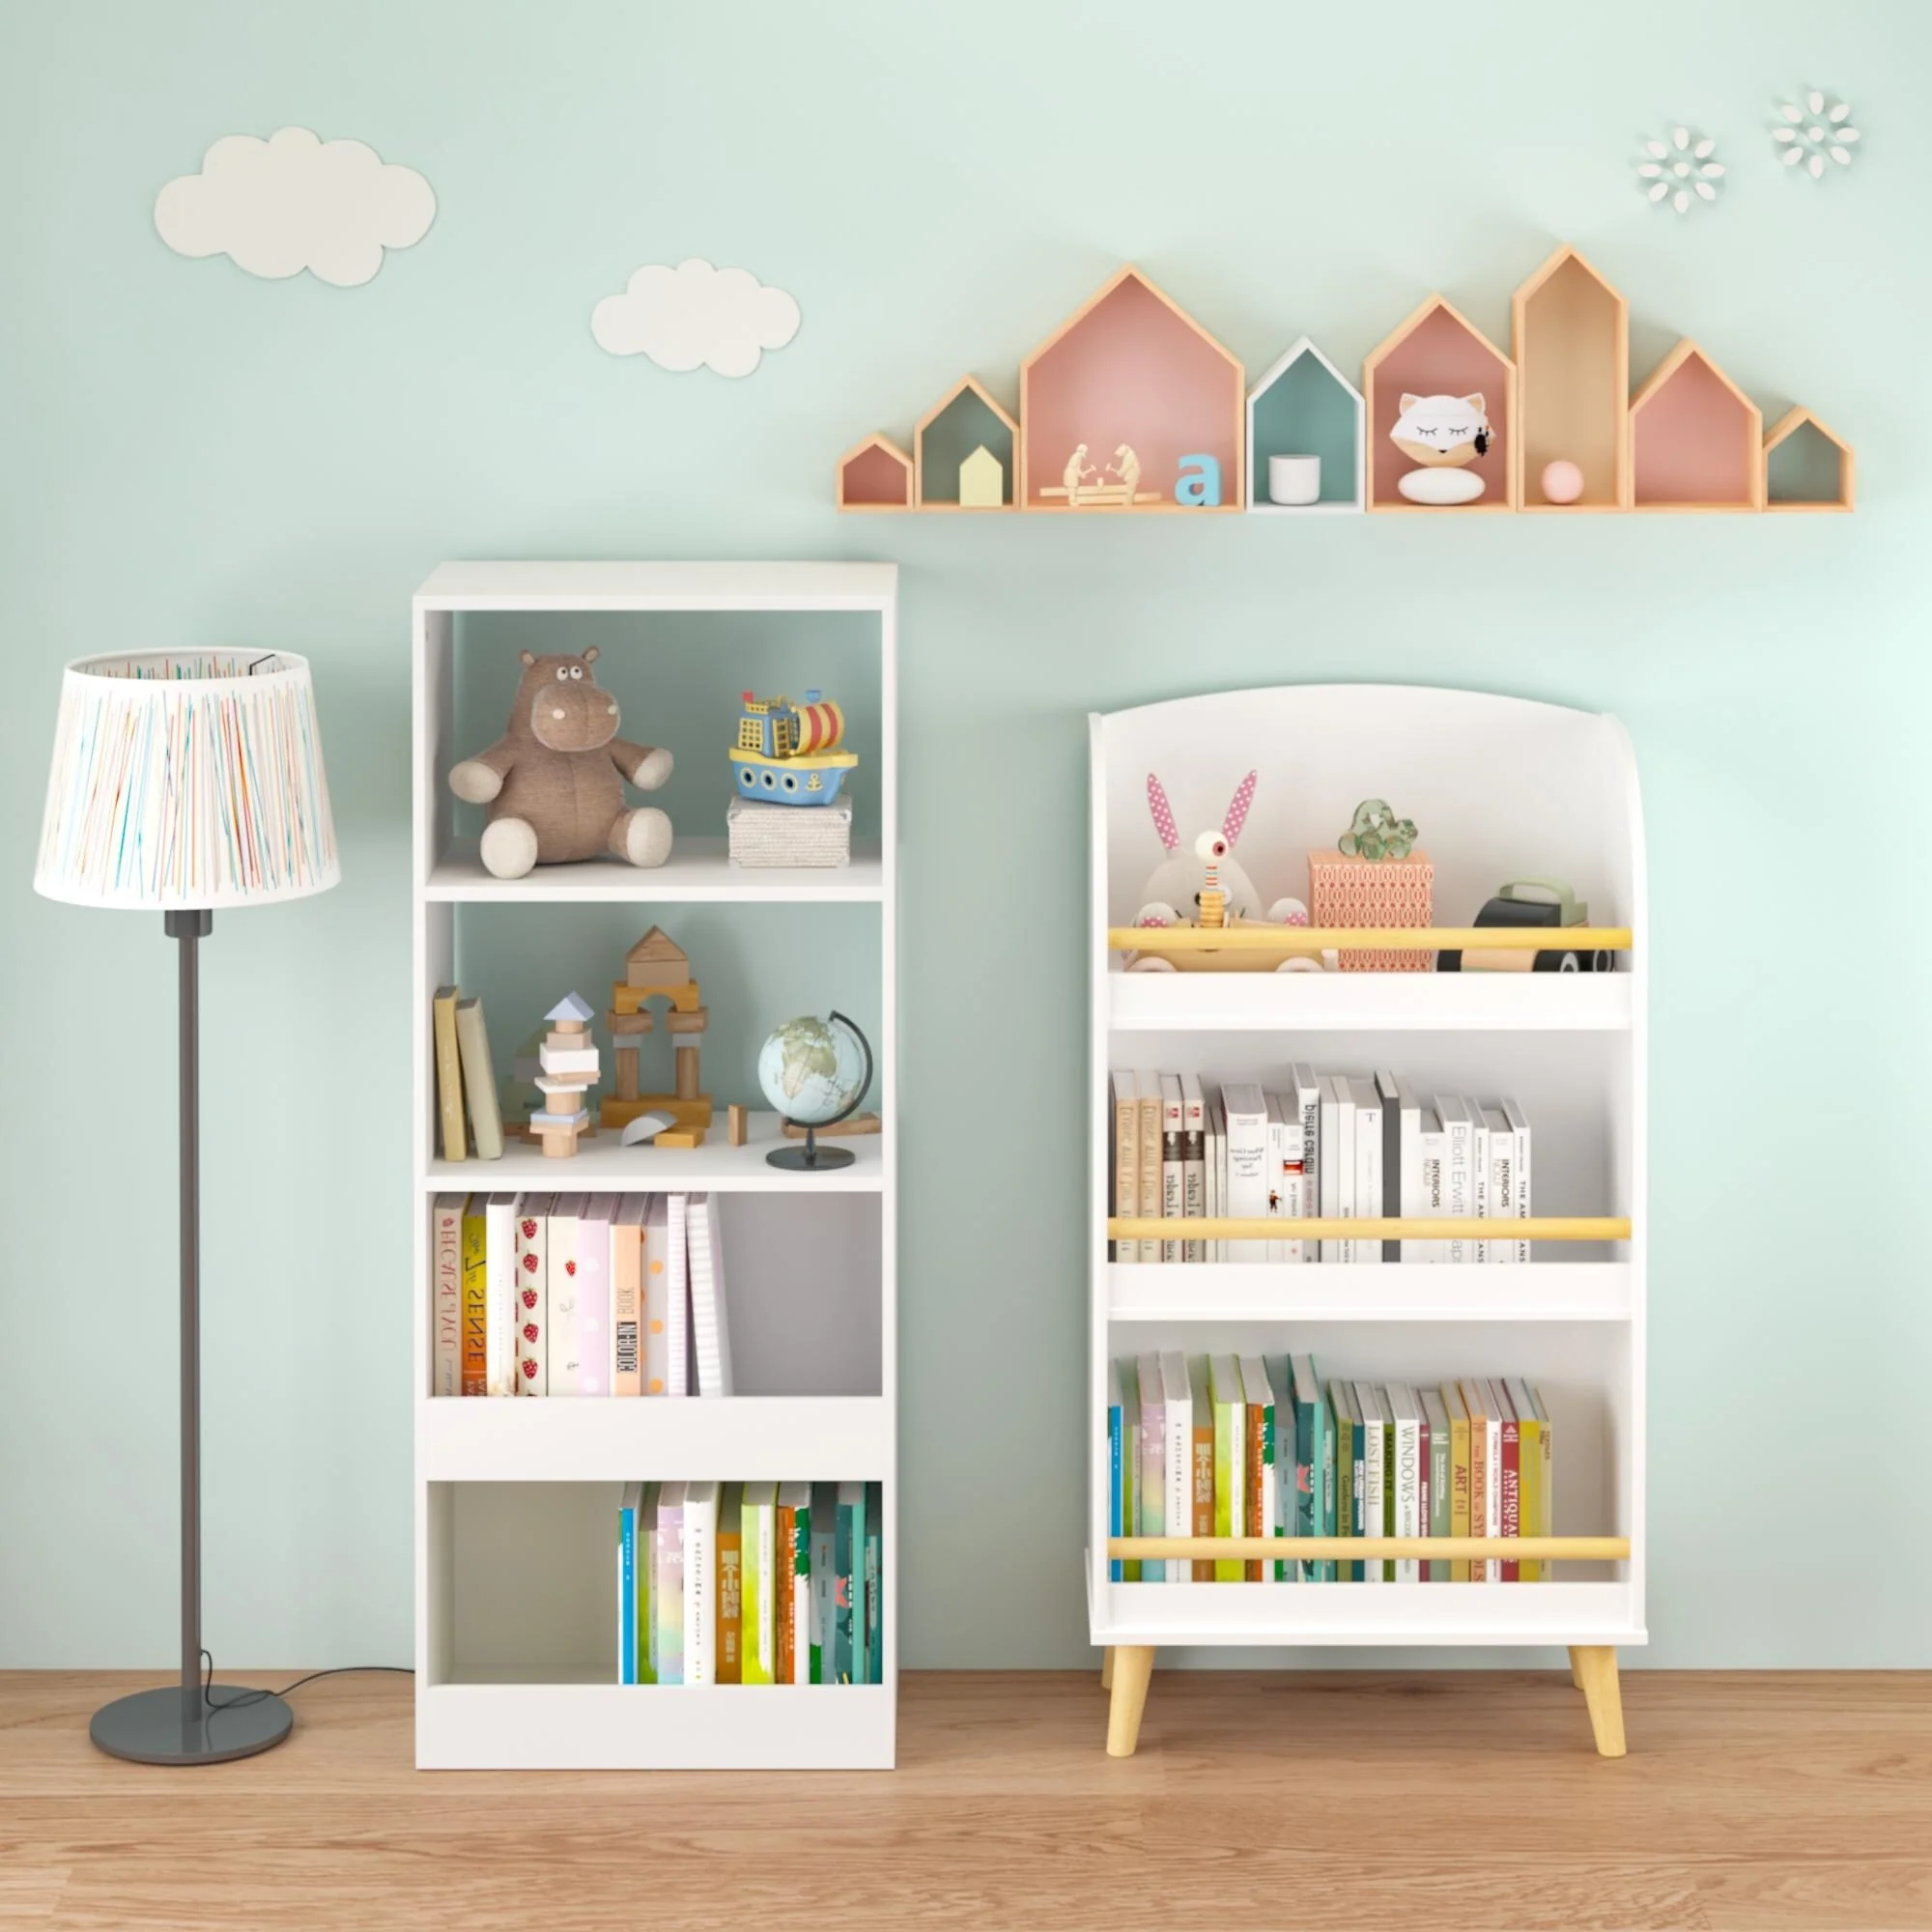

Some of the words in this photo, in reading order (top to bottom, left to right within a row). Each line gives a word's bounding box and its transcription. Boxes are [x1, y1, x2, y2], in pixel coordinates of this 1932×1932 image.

[1175, 453, 1222, 505] a
[1451, 1125, 1466, 1165] Elliott
[1432, 1158, 1440, 1208] INTERIORS
[1451, 1170, 1466, 1213] Erwitt
[1501, 1158, 1510, 1208] INTERIORS
[1367, 1425, 1380, 1467] LOST
[1384, 1433, 1393, 1477] MAKING
[1401, 1425, 1415, 1503] WINDOWS
[1367, 1470, 1380, 1505] FISH
[1384, 1480, 1393, 1492] IT
[1454, 1464, 1467, 1493] ART
[1473, 1461, 1484, 1499] BOOK
[1473, 1514, 1485, 1581] SYOLS
